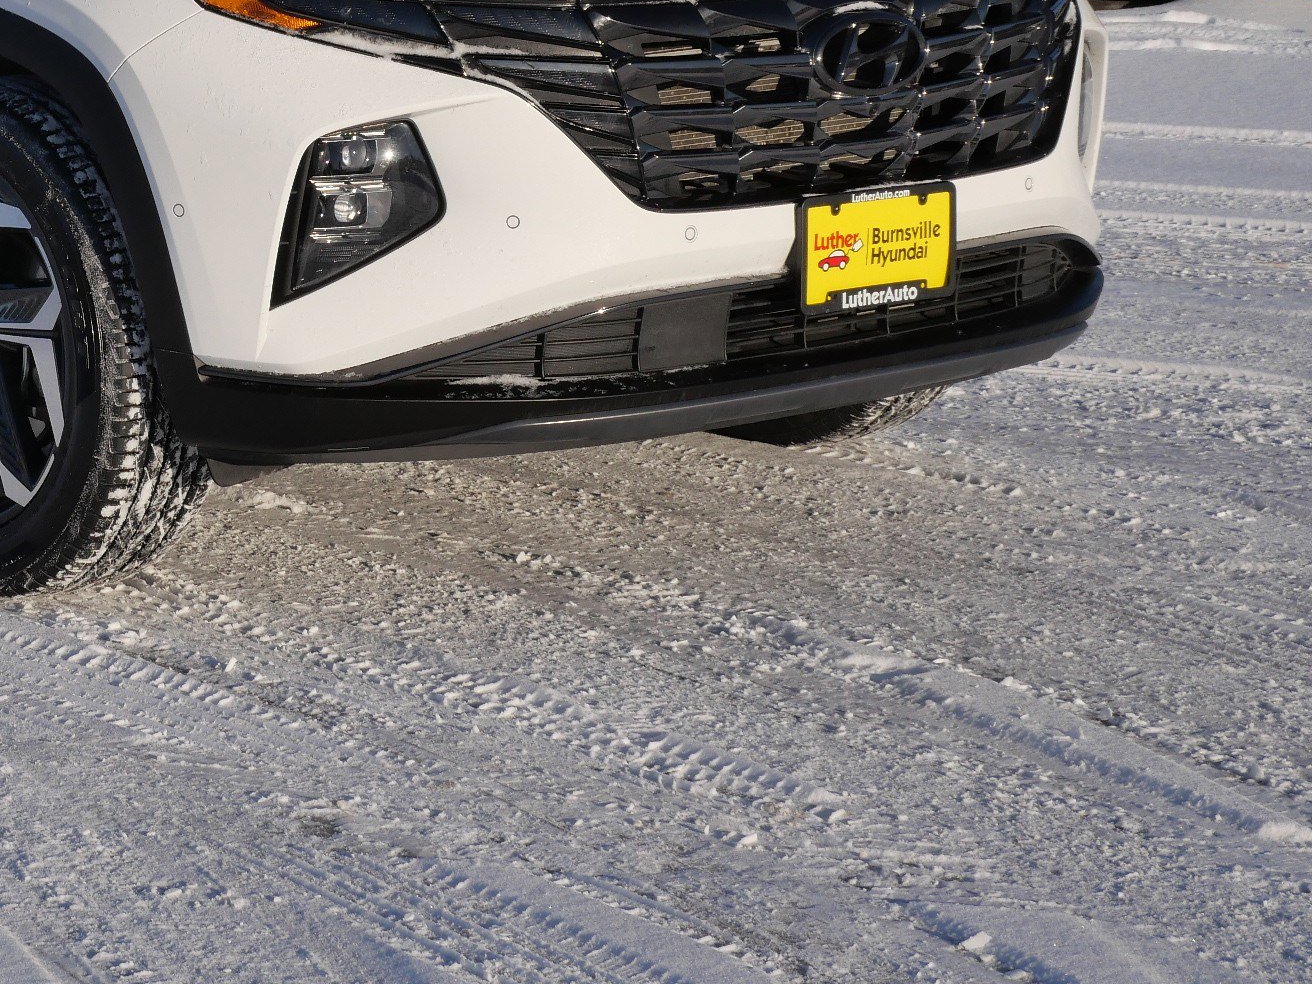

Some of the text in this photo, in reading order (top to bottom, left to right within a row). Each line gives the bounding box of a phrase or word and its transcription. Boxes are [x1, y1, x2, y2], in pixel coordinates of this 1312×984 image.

[851, 189, 910, 203] LutherAuto.com
[814, 231, 860, 251] Luther
[872, 220, 941, 245] Burnsville
[870, 241, 928, 267] Hyundai
[841, 285, 918, 309] LutherAuto
